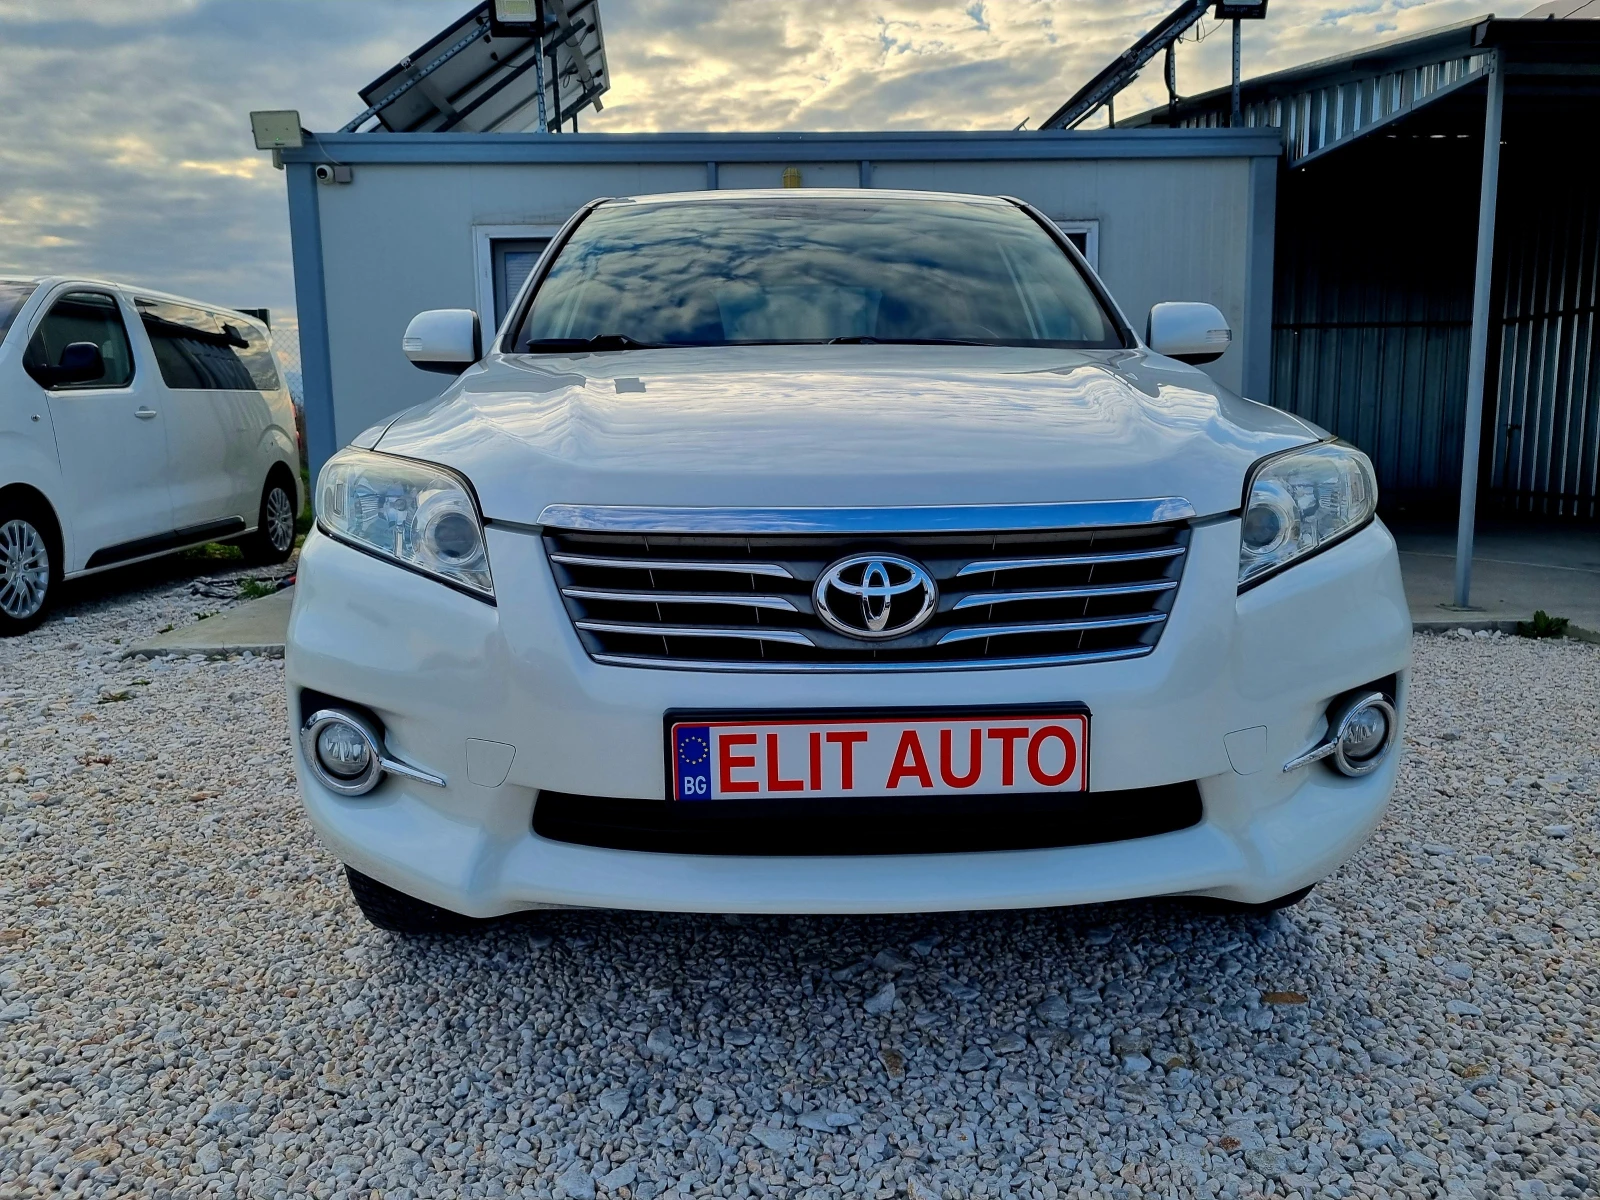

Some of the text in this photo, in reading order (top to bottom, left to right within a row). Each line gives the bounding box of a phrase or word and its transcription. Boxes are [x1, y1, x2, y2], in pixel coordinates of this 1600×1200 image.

[718, 725, 1077, 793] ELIT AUTO
[684, 775, 707, 795] BG
